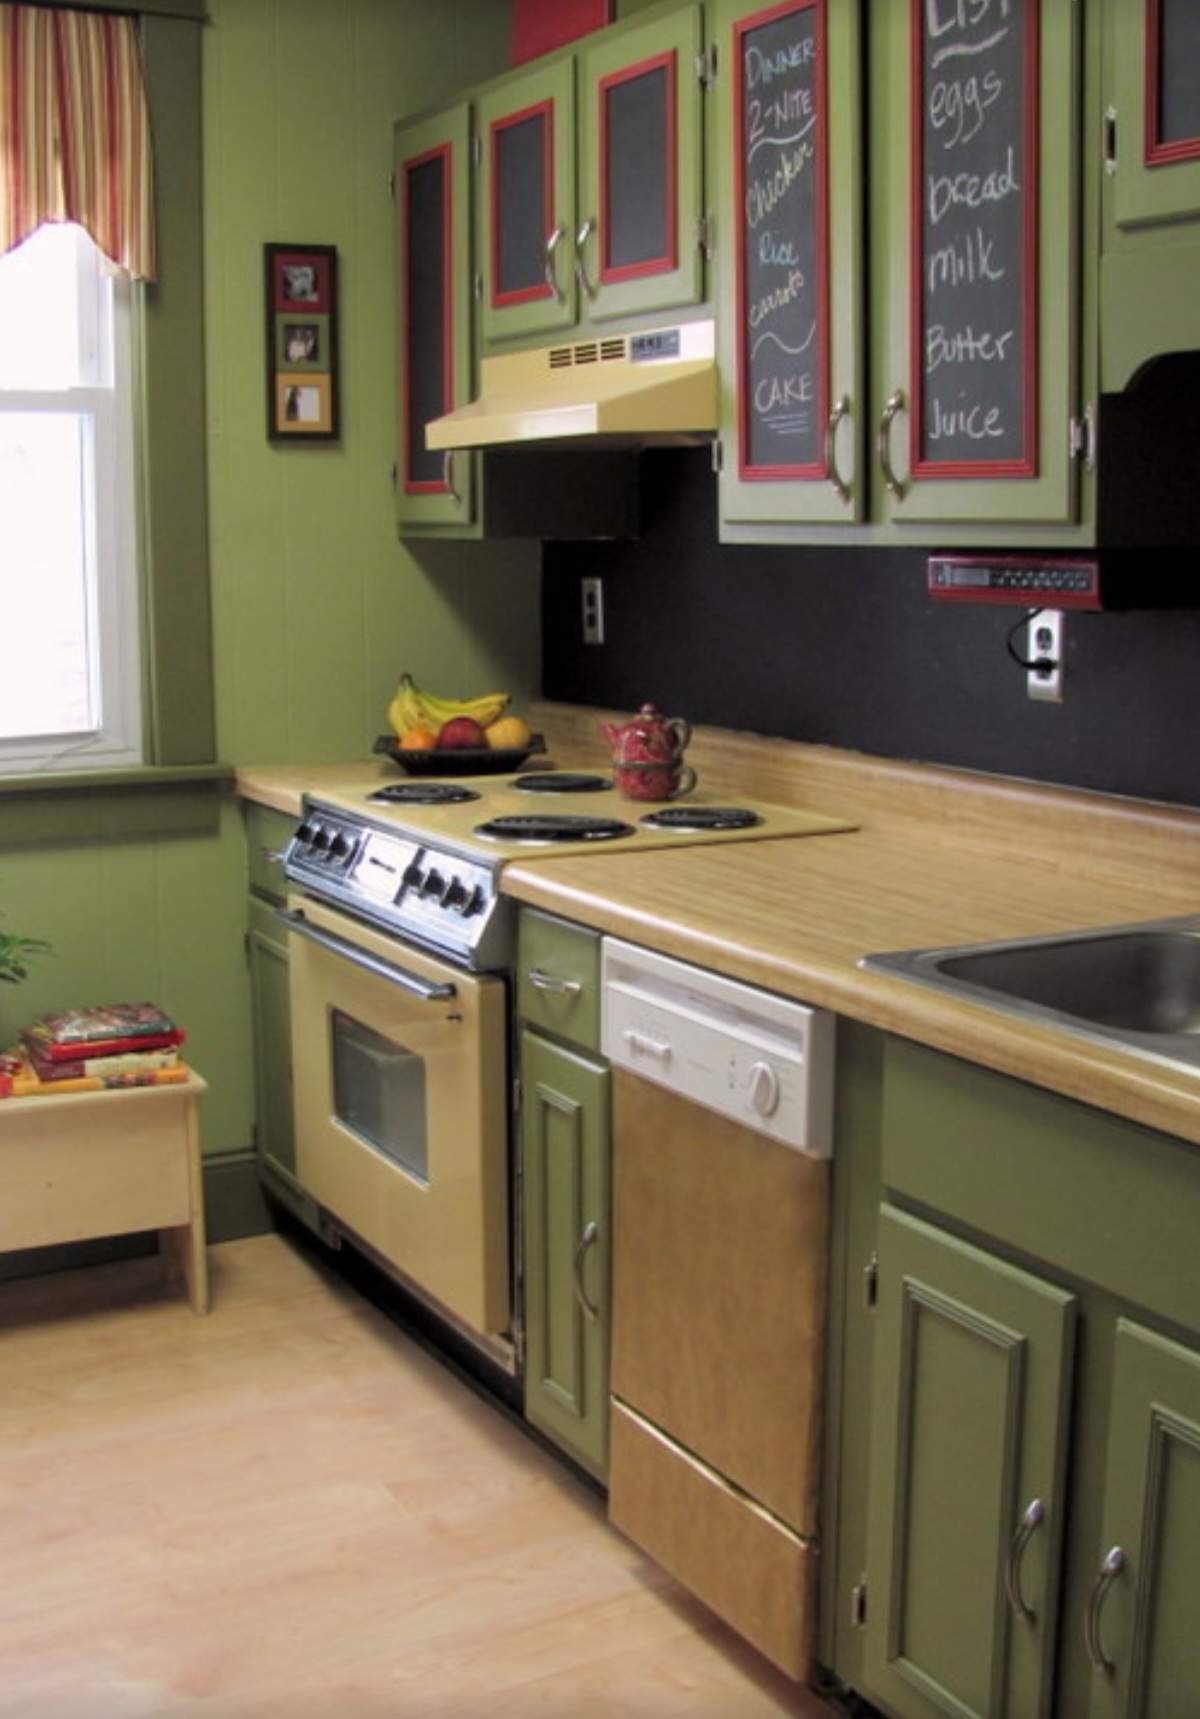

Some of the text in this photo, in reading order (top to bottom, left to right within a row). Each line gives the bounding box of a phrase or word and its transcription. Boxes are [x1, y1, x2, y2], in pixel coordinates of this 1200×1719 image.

[745, 37, 815, 88] DINNER
[929, 69, 1001, 149] eggs
[926, 324, 1013, 374] Butter
[754, 373, 813, 413] CAKE
